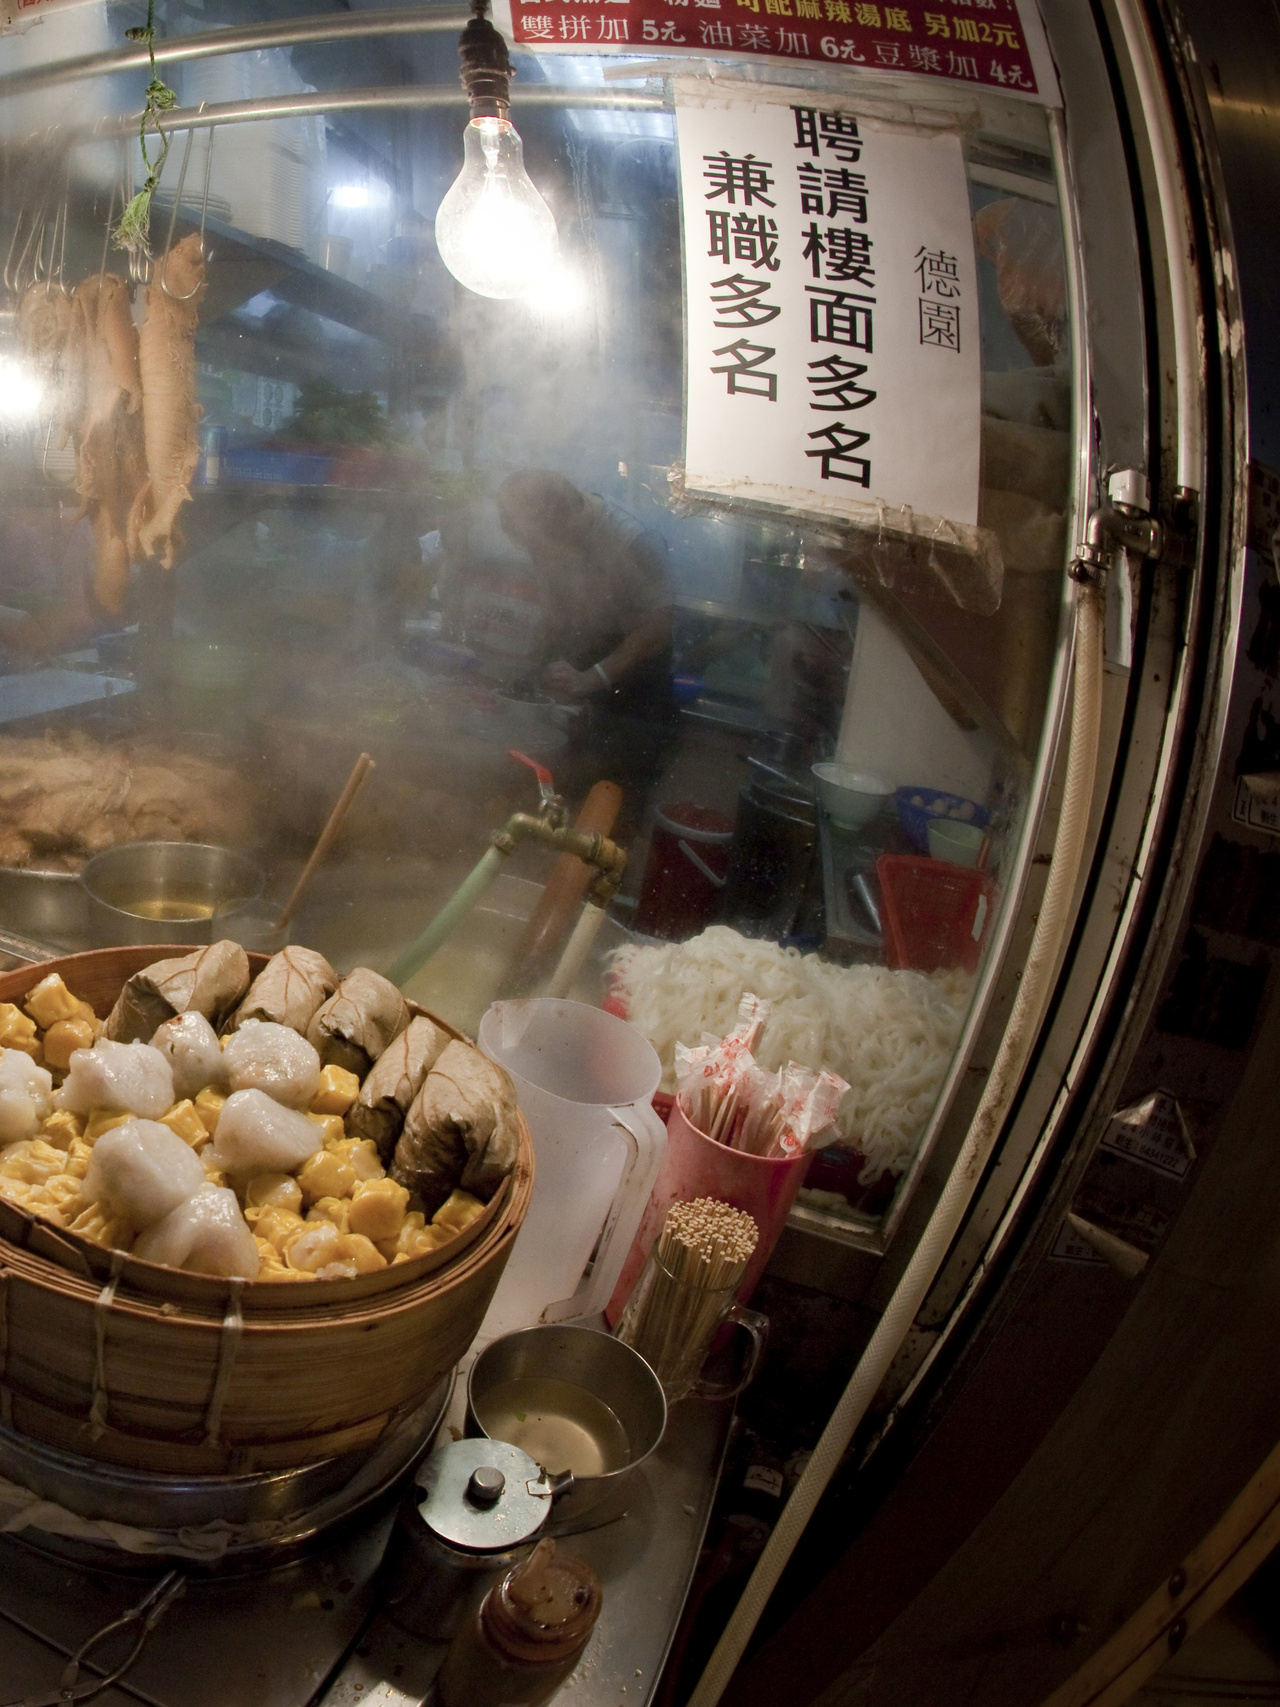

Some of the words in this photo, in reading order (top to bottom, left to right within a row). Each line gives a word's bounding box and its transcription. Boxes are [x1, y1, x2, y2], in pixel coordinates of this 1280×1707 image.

[521, 15, 629, 40] 雙拼加
[642, 19, 686, 43] 5元
[698, 20, 809, 56] 油菜加
[820, 36, 866, 62] 6元
[872, 40, 979, 80] 豆漿加
[990, 60, 1032, 89] 4元
[924, 11, 1020, 50] 另加2元
[702, 151, 782, 403] 兼職多名
[790, 104, 878, 488] 聘請樓面多名
[914, 243, 961, 355] 德園
